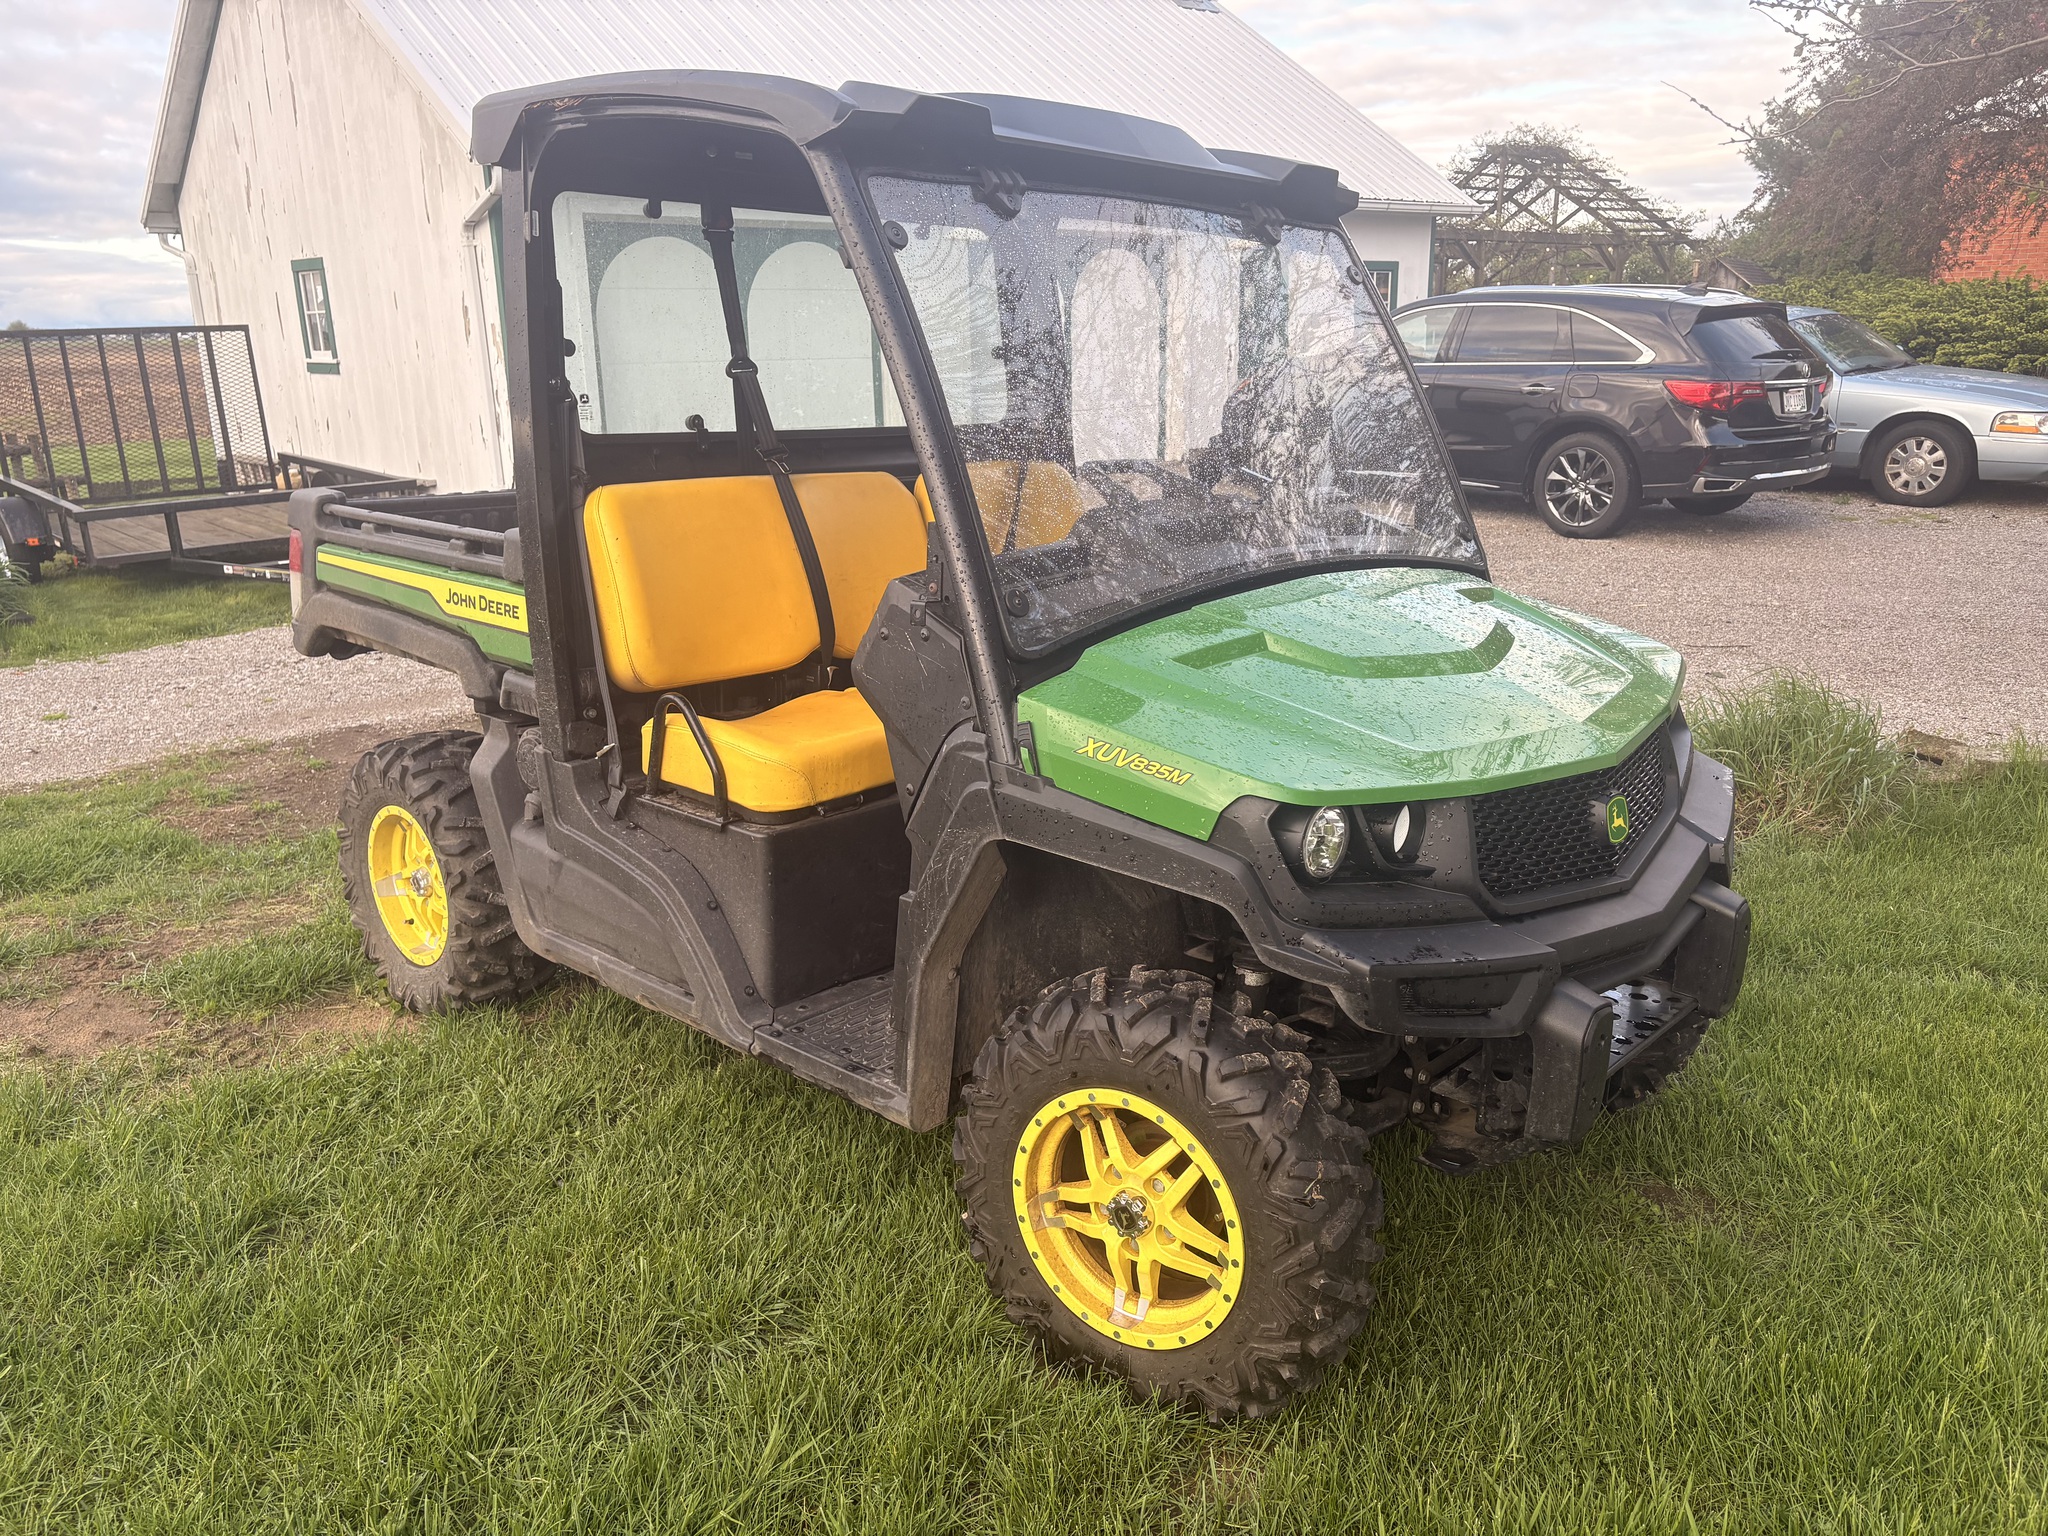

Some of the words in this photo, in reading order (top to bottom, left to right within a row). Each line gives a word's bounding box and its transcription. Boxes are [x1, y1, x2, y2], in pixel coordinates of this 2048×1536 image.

[446, 588, 476, 610] JOHN
[478, 594, 519, 619] DEERE
[1074, 736, 1194, 786] XUV835M
